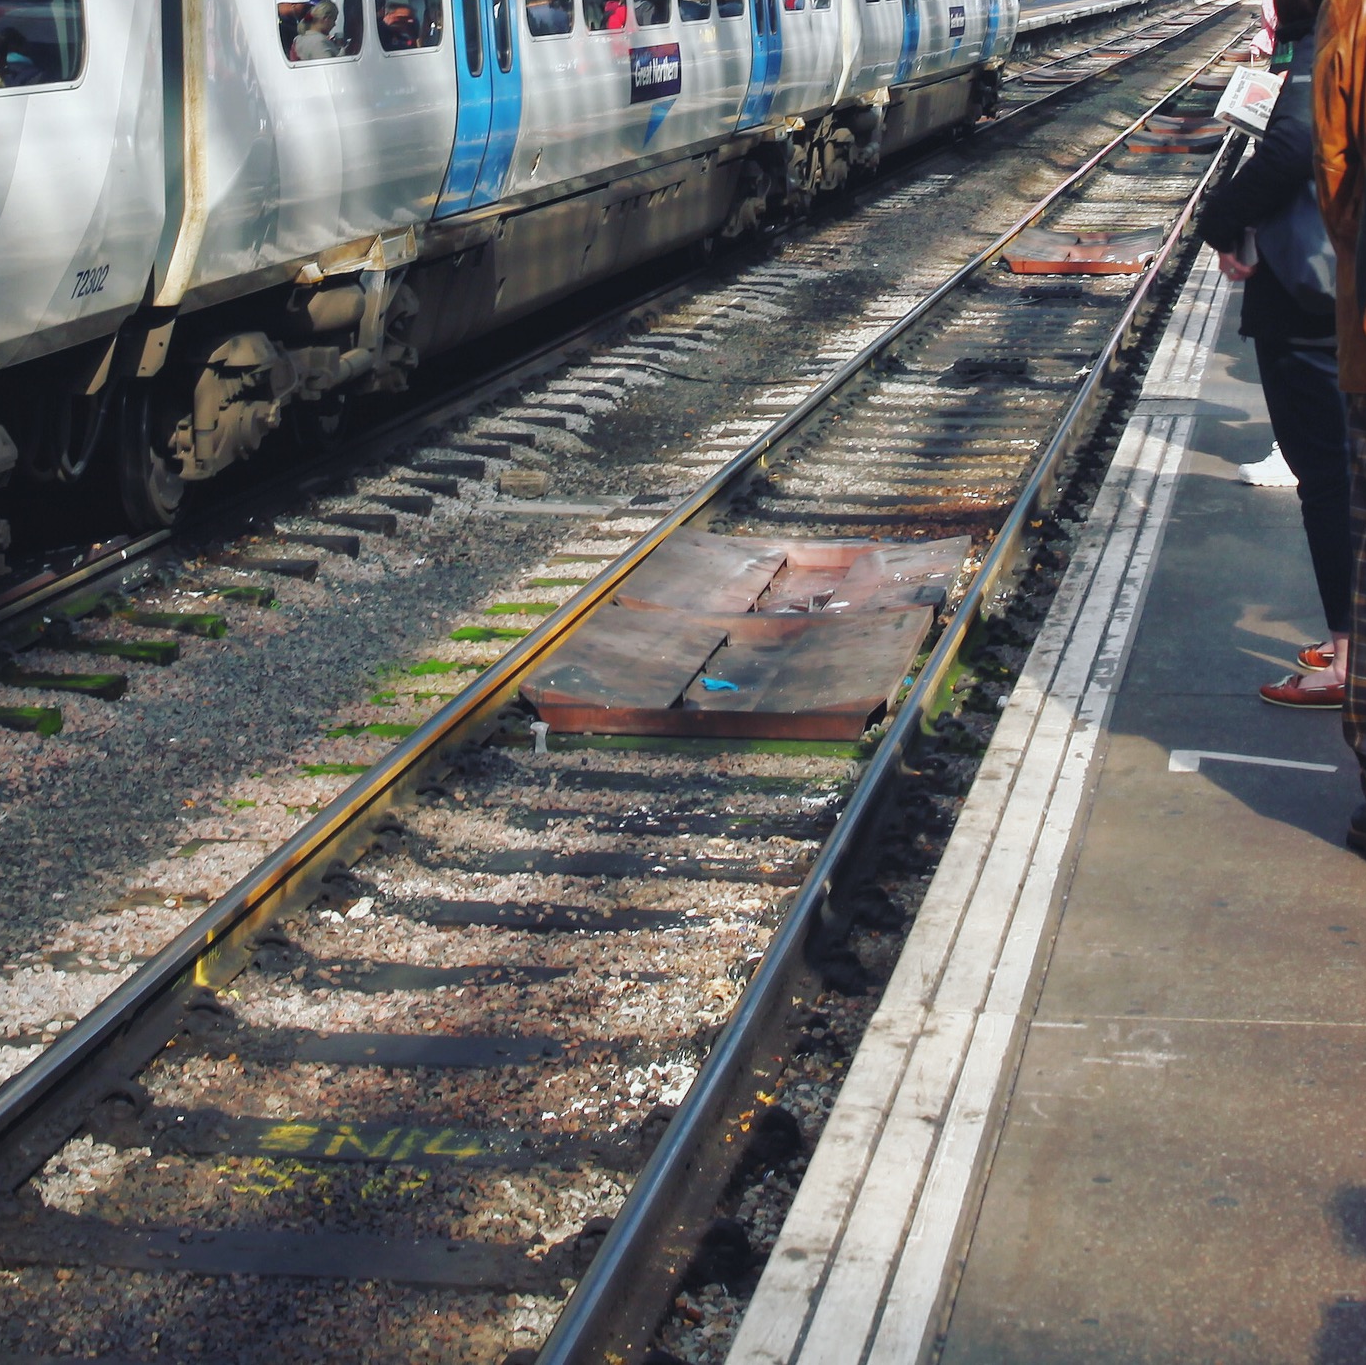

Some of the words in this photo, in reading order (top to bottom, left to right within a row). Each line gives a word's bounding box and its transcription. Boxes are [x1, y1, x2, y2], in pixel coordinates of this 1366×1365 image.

[635, 59, 652, 88] Great
[652, 55, 679, 84] Northern
[71, 264, 110, 300] 72302
